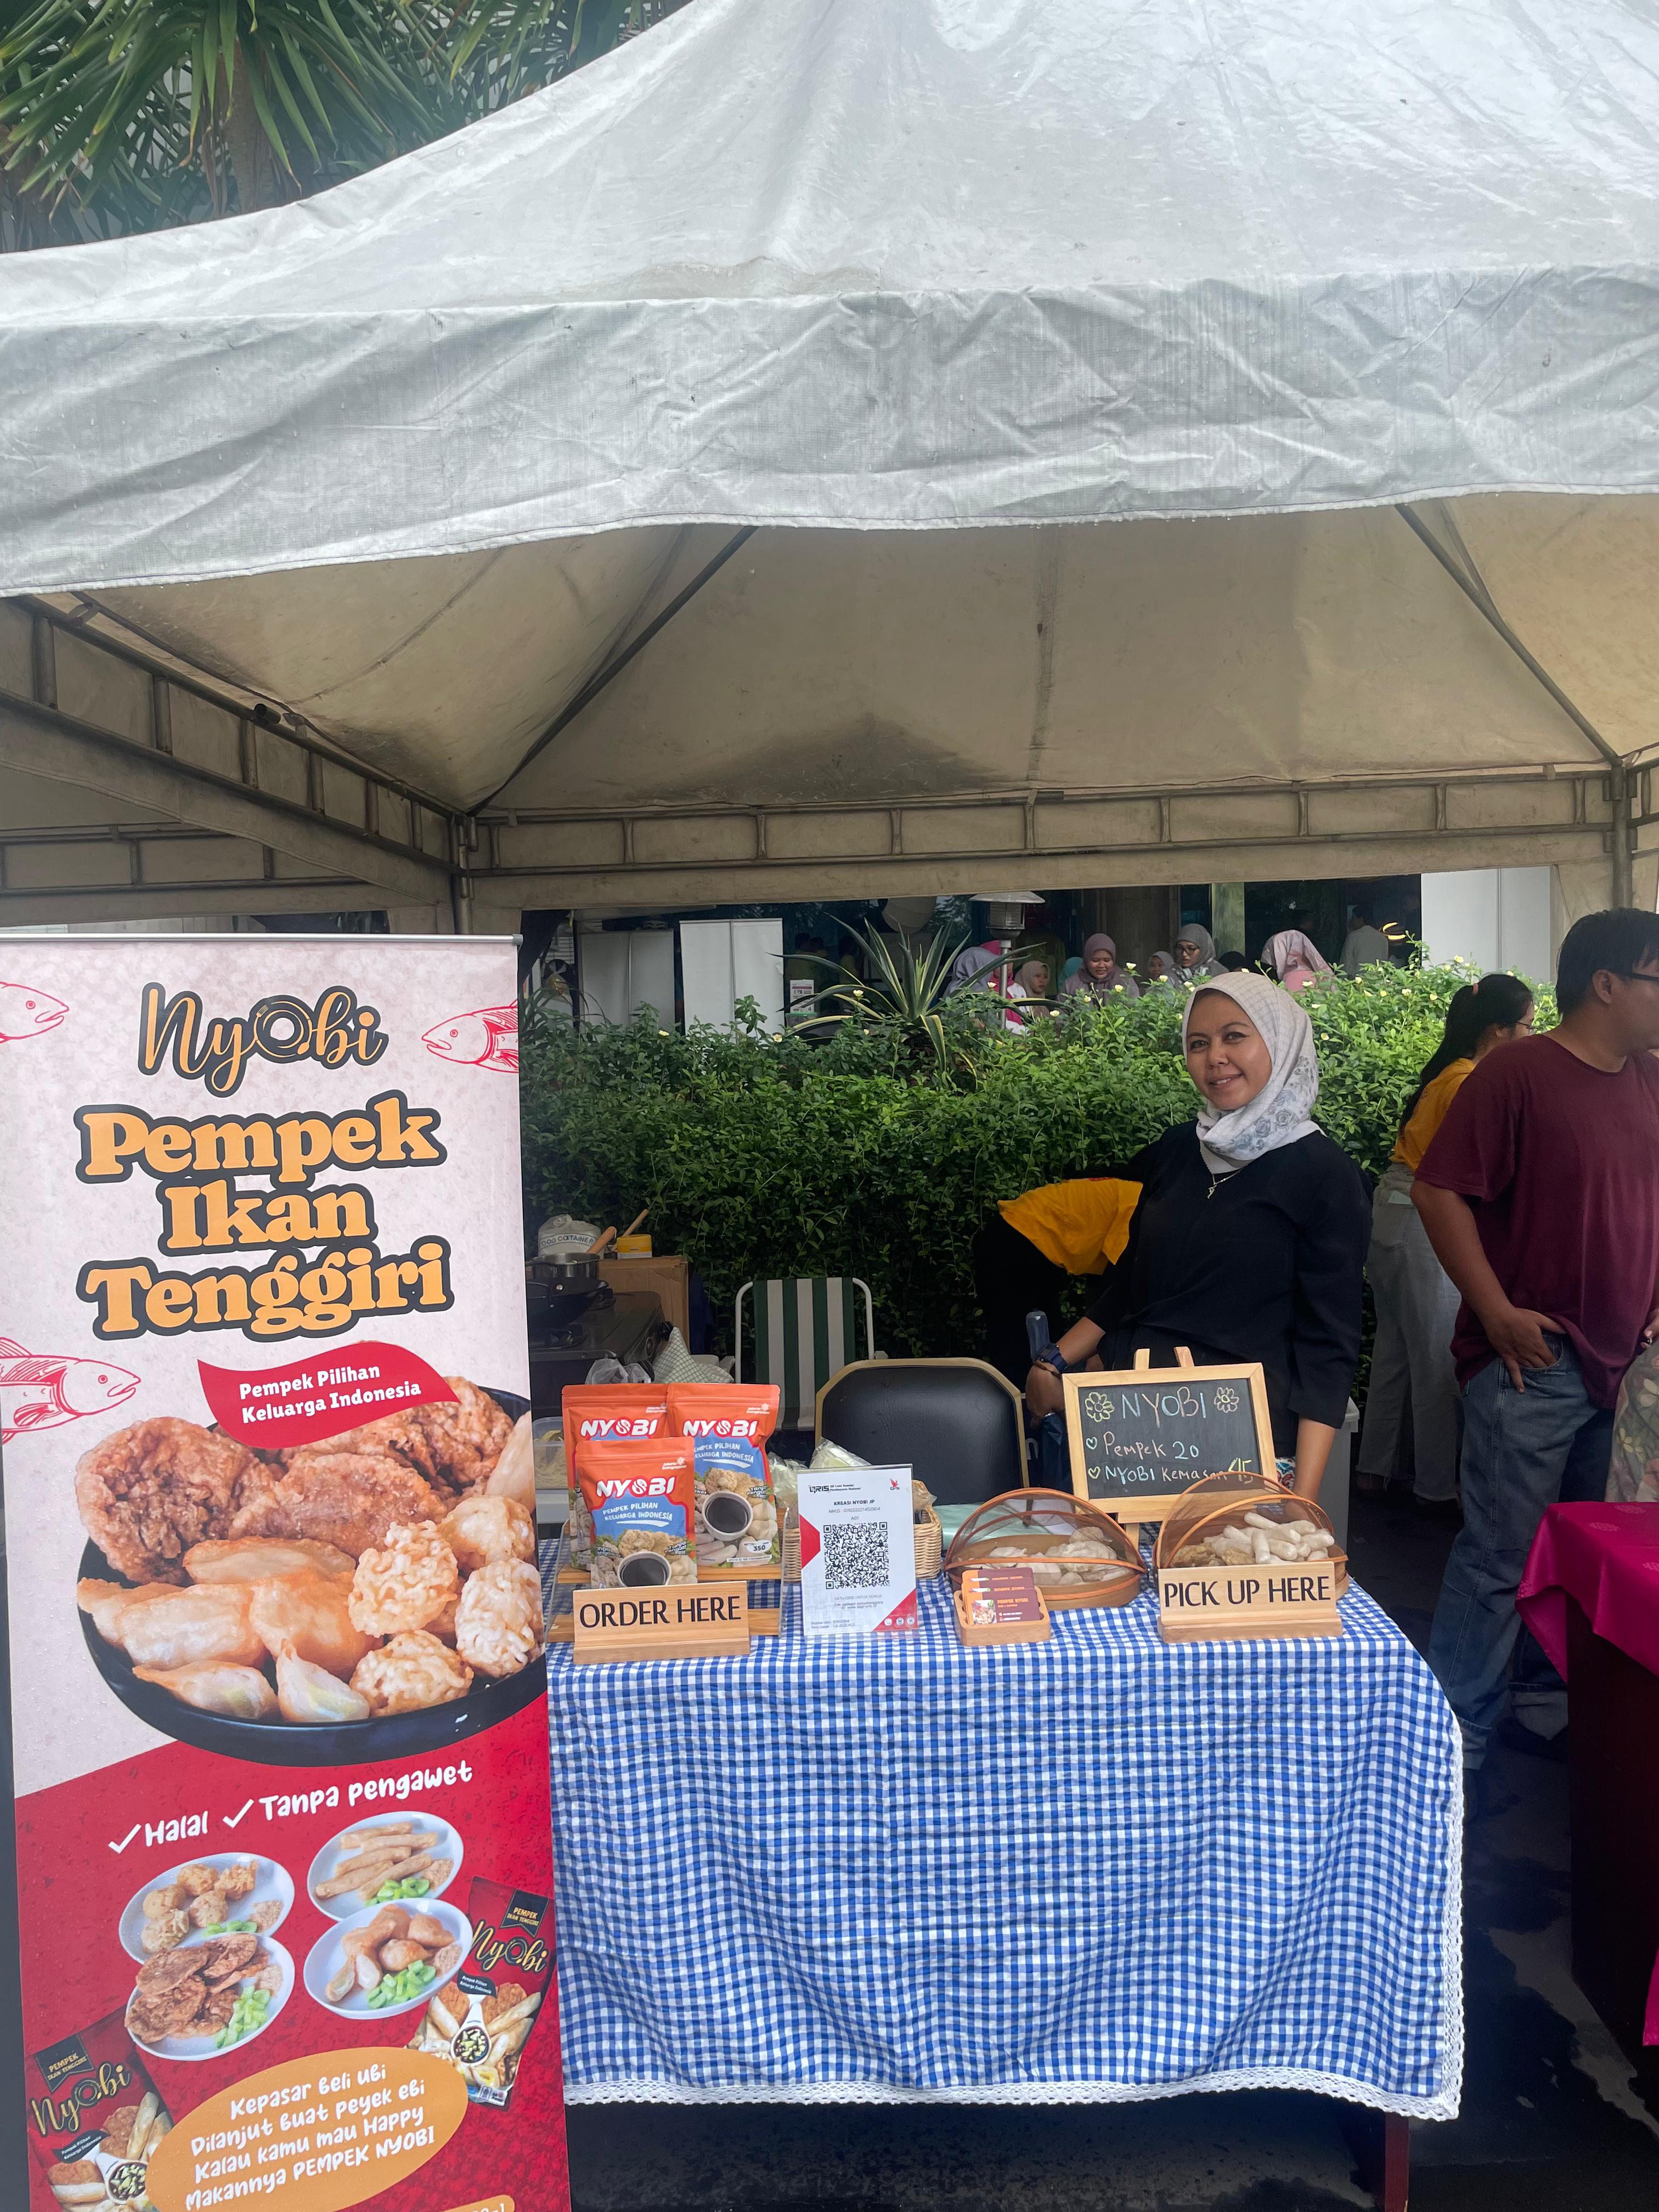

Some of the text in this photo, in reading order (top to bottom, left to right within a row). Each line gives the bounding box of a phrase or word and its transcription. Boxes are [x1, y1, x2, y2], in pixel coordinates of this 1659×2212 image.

[80, 1095, 443, 1185] Pempek
[162, 1178, 372, 1251] Ikan
[83, 1241, 449, 1337] Tenggiri
[239, 1366, 380, 1400] Pempek Pilihan
[242, 1381, 421, 1424] Keluarga Indonesia
[1121, 1386, 1206, 1428] NYOBI
[580, 1419, 658, 1437] NYOBI
[682, 1420, 758, 1437] NYOBI
[694, 1444, 713, 1452] EMPEK
[722, 1451, 754, 1463] INDONESIA
[1172, 1441, 1199, 1459] 20
[596, 1477, 675, 1498] NYOBI
[1105, 1465, 1155, 1485] NYOBI
[603, 1504, 629, 1515] PEMPEK
[605, 1511, 673, 1521] KELUARGA INDONESIA
[1164, 1576, 1331, 1607] PICK UP HERE
[580, 1595, 741, 1628] ORDER HERE
[144, 1760, 473, 1847] Halal Tanpa pengawet
[513, 1907, 538, 1920] PEMPEK
[49, 2052, 79, 2072] PEMPEK
[230, 2083, 311, 2120] Kepasar
[191, 2119, 273, 2156] Dilanjut
[336, 2088, 392, 2120] peyek
[195, 2107, 424, 2183] Kalau kamu mau Happy
[185, 2125, 435, 2211] Makannya PEMPEK NYOBI
